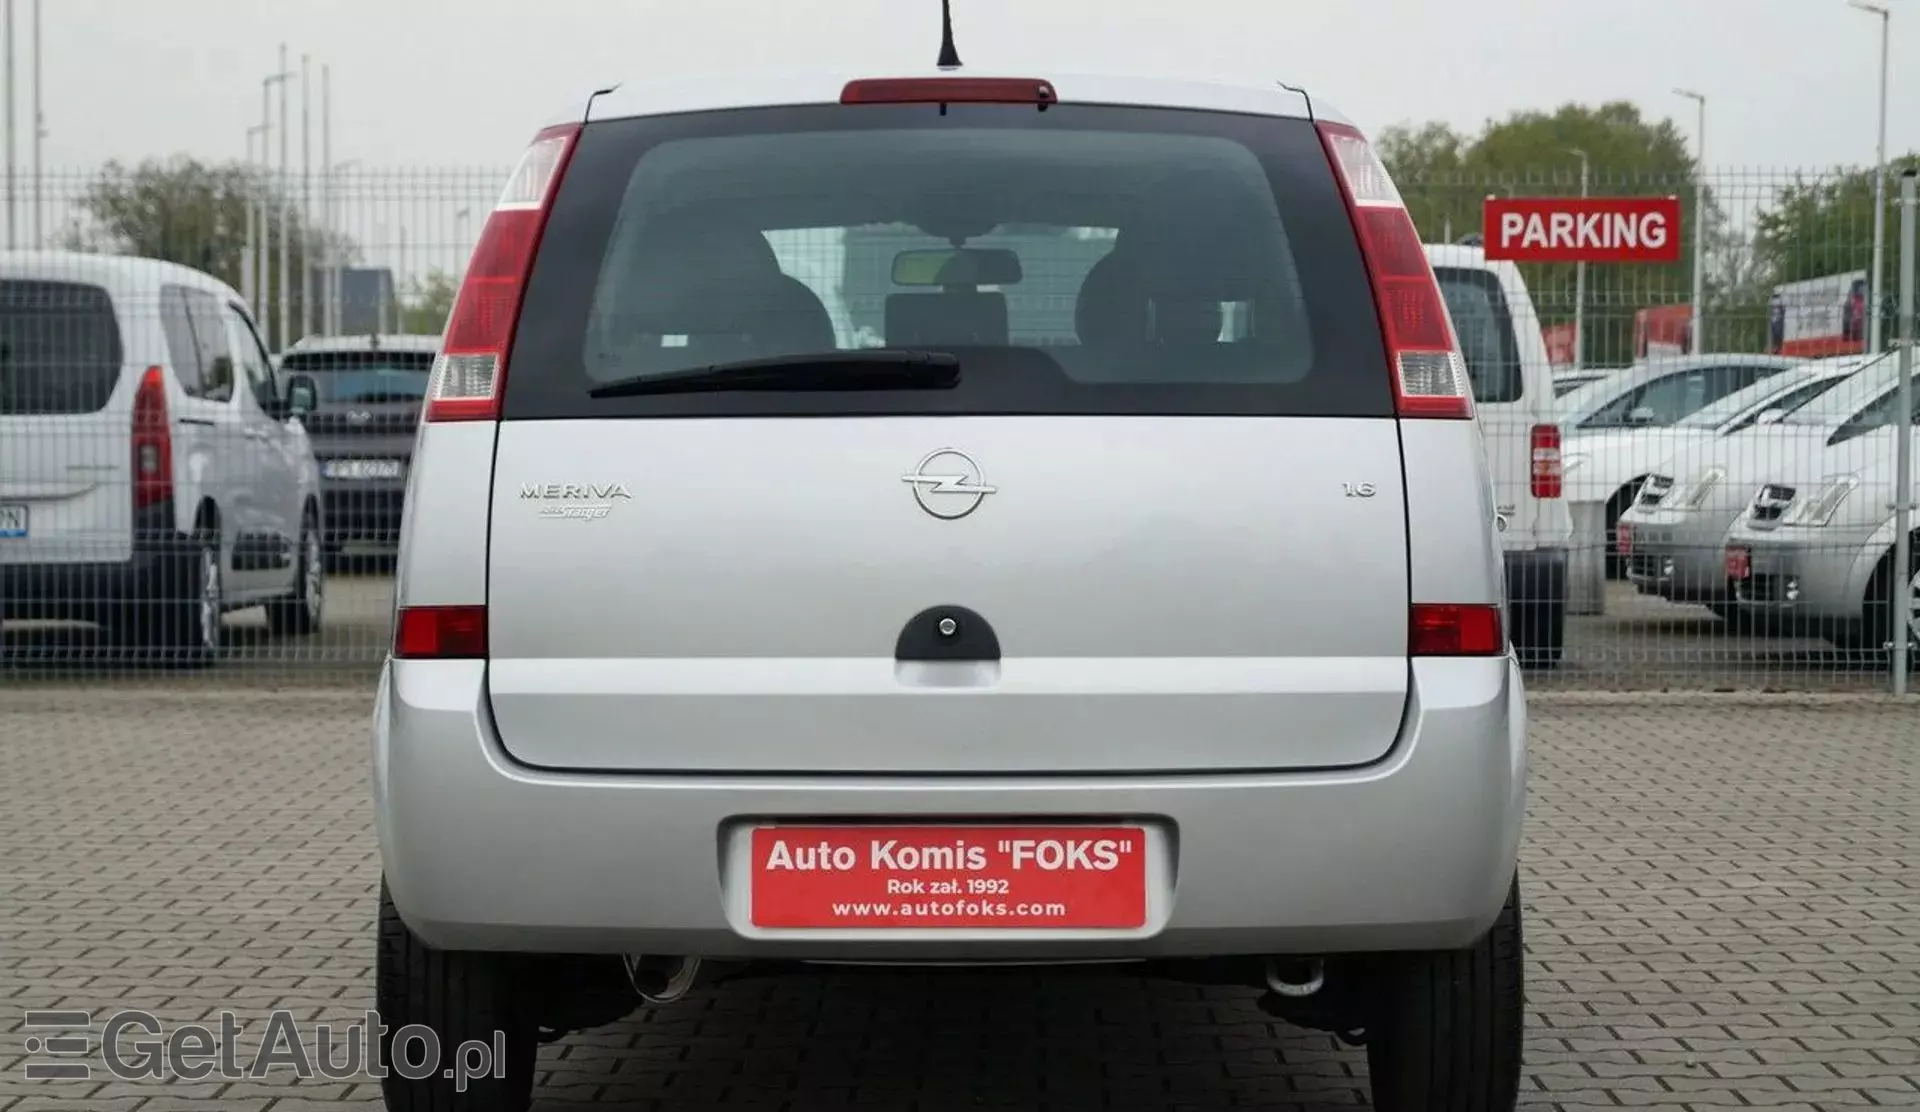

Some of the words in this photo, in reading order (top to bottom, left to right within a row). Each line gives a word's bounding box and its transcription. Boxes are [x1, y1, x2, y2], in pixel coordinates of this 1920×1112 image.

[1501, 212, 1666, 249] PARKING
[520, 482, 632, 500] MERIVA
[766, 840, 856, 871] Auto
[871, 840, 987, 871] Komis
[998, 840, 1132, 871] "FOKS"
[887, 878, 925, 895] Rok
[929, 878, 963, 895] zał.
[966, 878, 1010, 895] 1992
[832, 899, 1066, 917] www.autofoks.com
